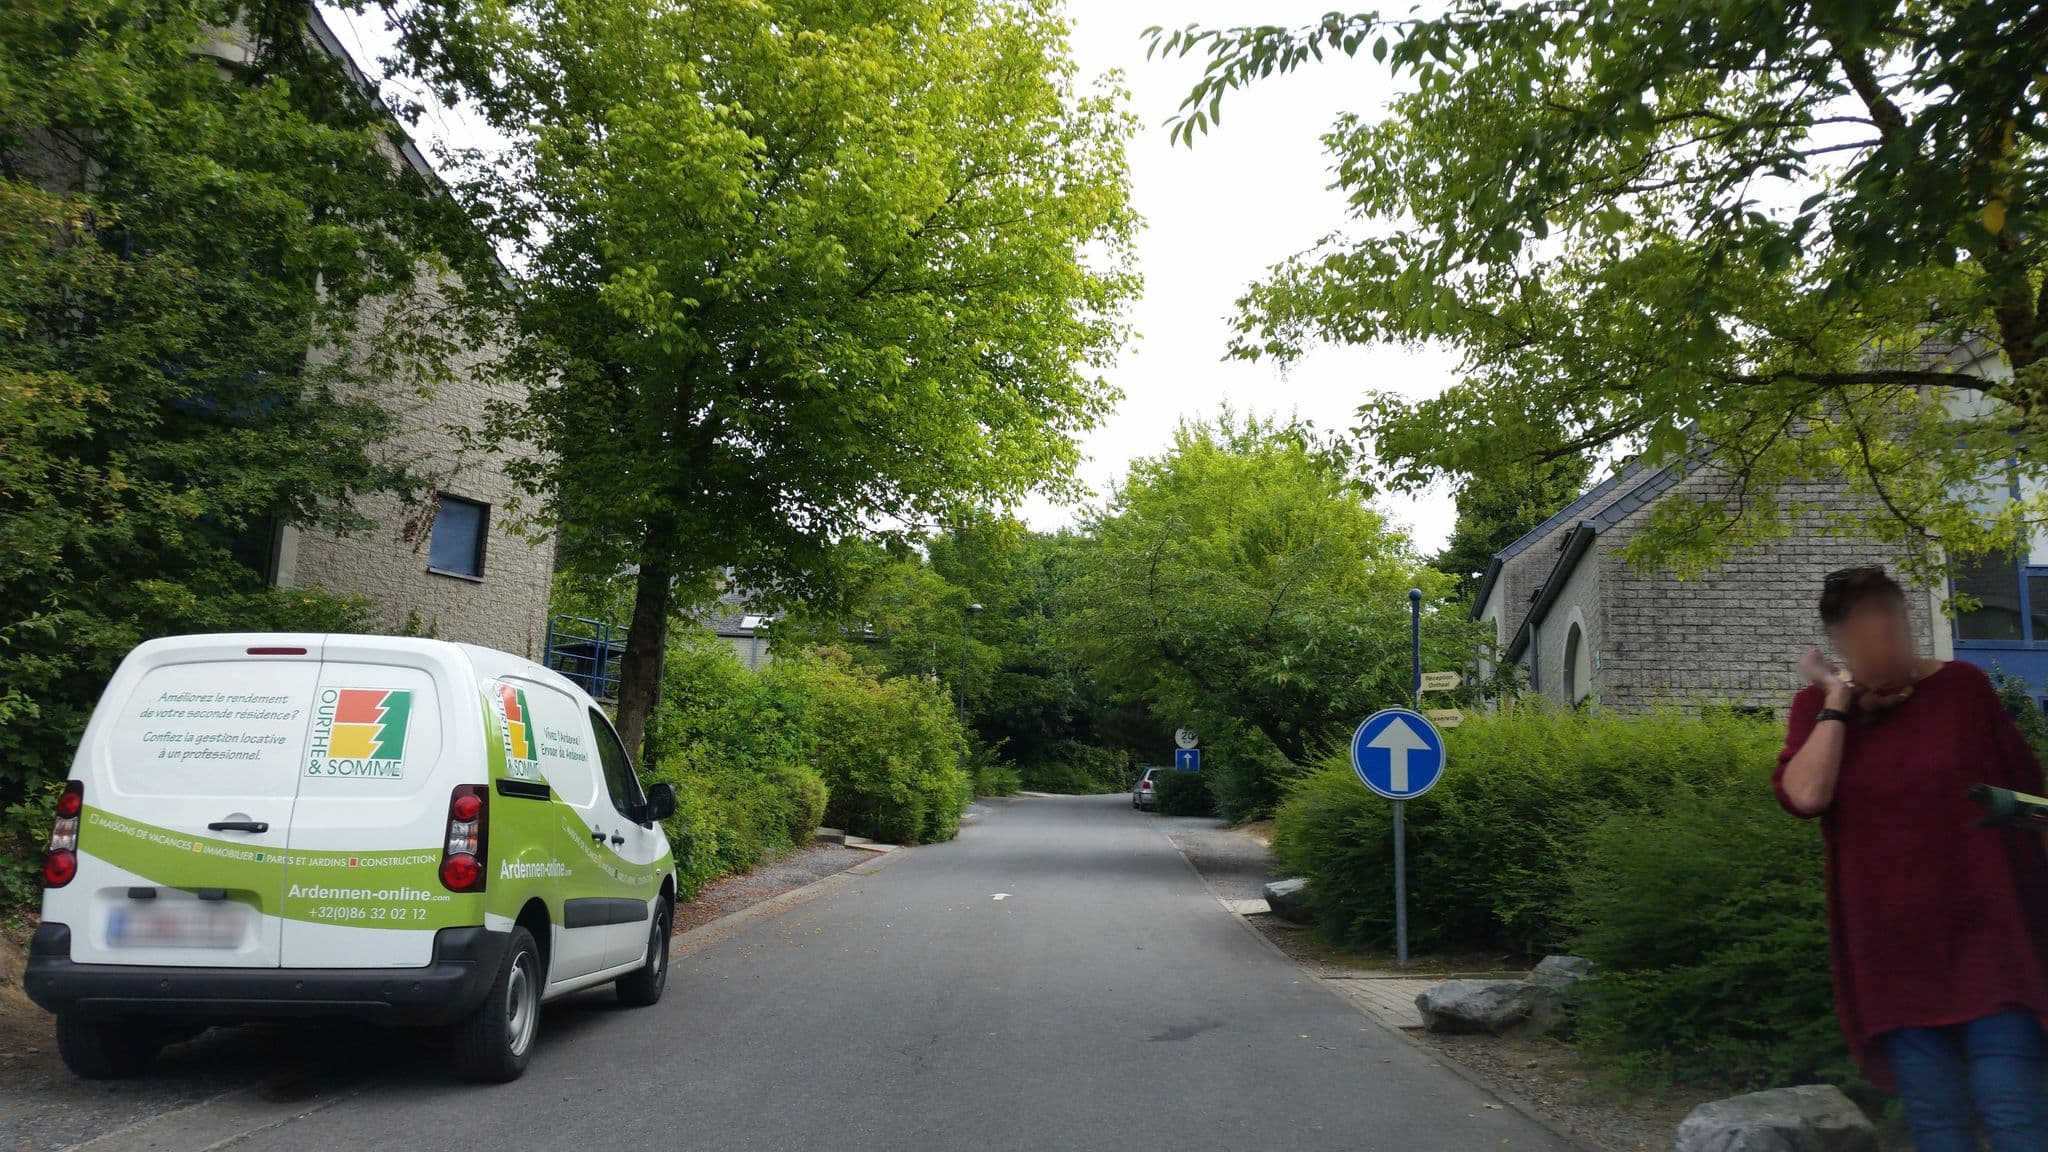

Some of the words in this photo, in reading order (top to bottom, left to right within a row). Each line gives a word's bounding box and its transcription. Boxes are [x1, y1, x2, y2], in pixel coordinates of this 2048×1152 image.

[158, 692, 213, 703] Améliorez
[215, 692, 226, 703] le
[227, 693, 288, 704] rendement
[139, 708, 153, 718] de
[155, 708, 185, 718] votre
[187, 708, 233, 719] seconde
[311, 690, 337, 757] OURTHE
[142, 731, 182, 743] Confiez
[184, 731, 194, 743] la
[195, 732, 238, 745] gestion
[240, 732, 286, 744] locative
[1181, 731, 1194, 740] 20
[168, 750, 181, 759] un
[308, 759, 321, 775] &
[327, 760, 402, 776] SOMME
[99, 818, 135, 836] MAISONS
[136, 829, 149, 840] DE
[150, 833, 192, 851] VACANCES
[203, 846, 253, 861] IMMOBILIER
[266, 854, 294, 865] PARCS
[296, 857, 306, 865] ET
[308, 857, 346, 867] JARDINS
[360, 854, 436, 867] CONSTRUCTION
[370, 908, 386, 920] 32
[391, 908, 406, 920] 02
[412, 908, 426, 920] 12
